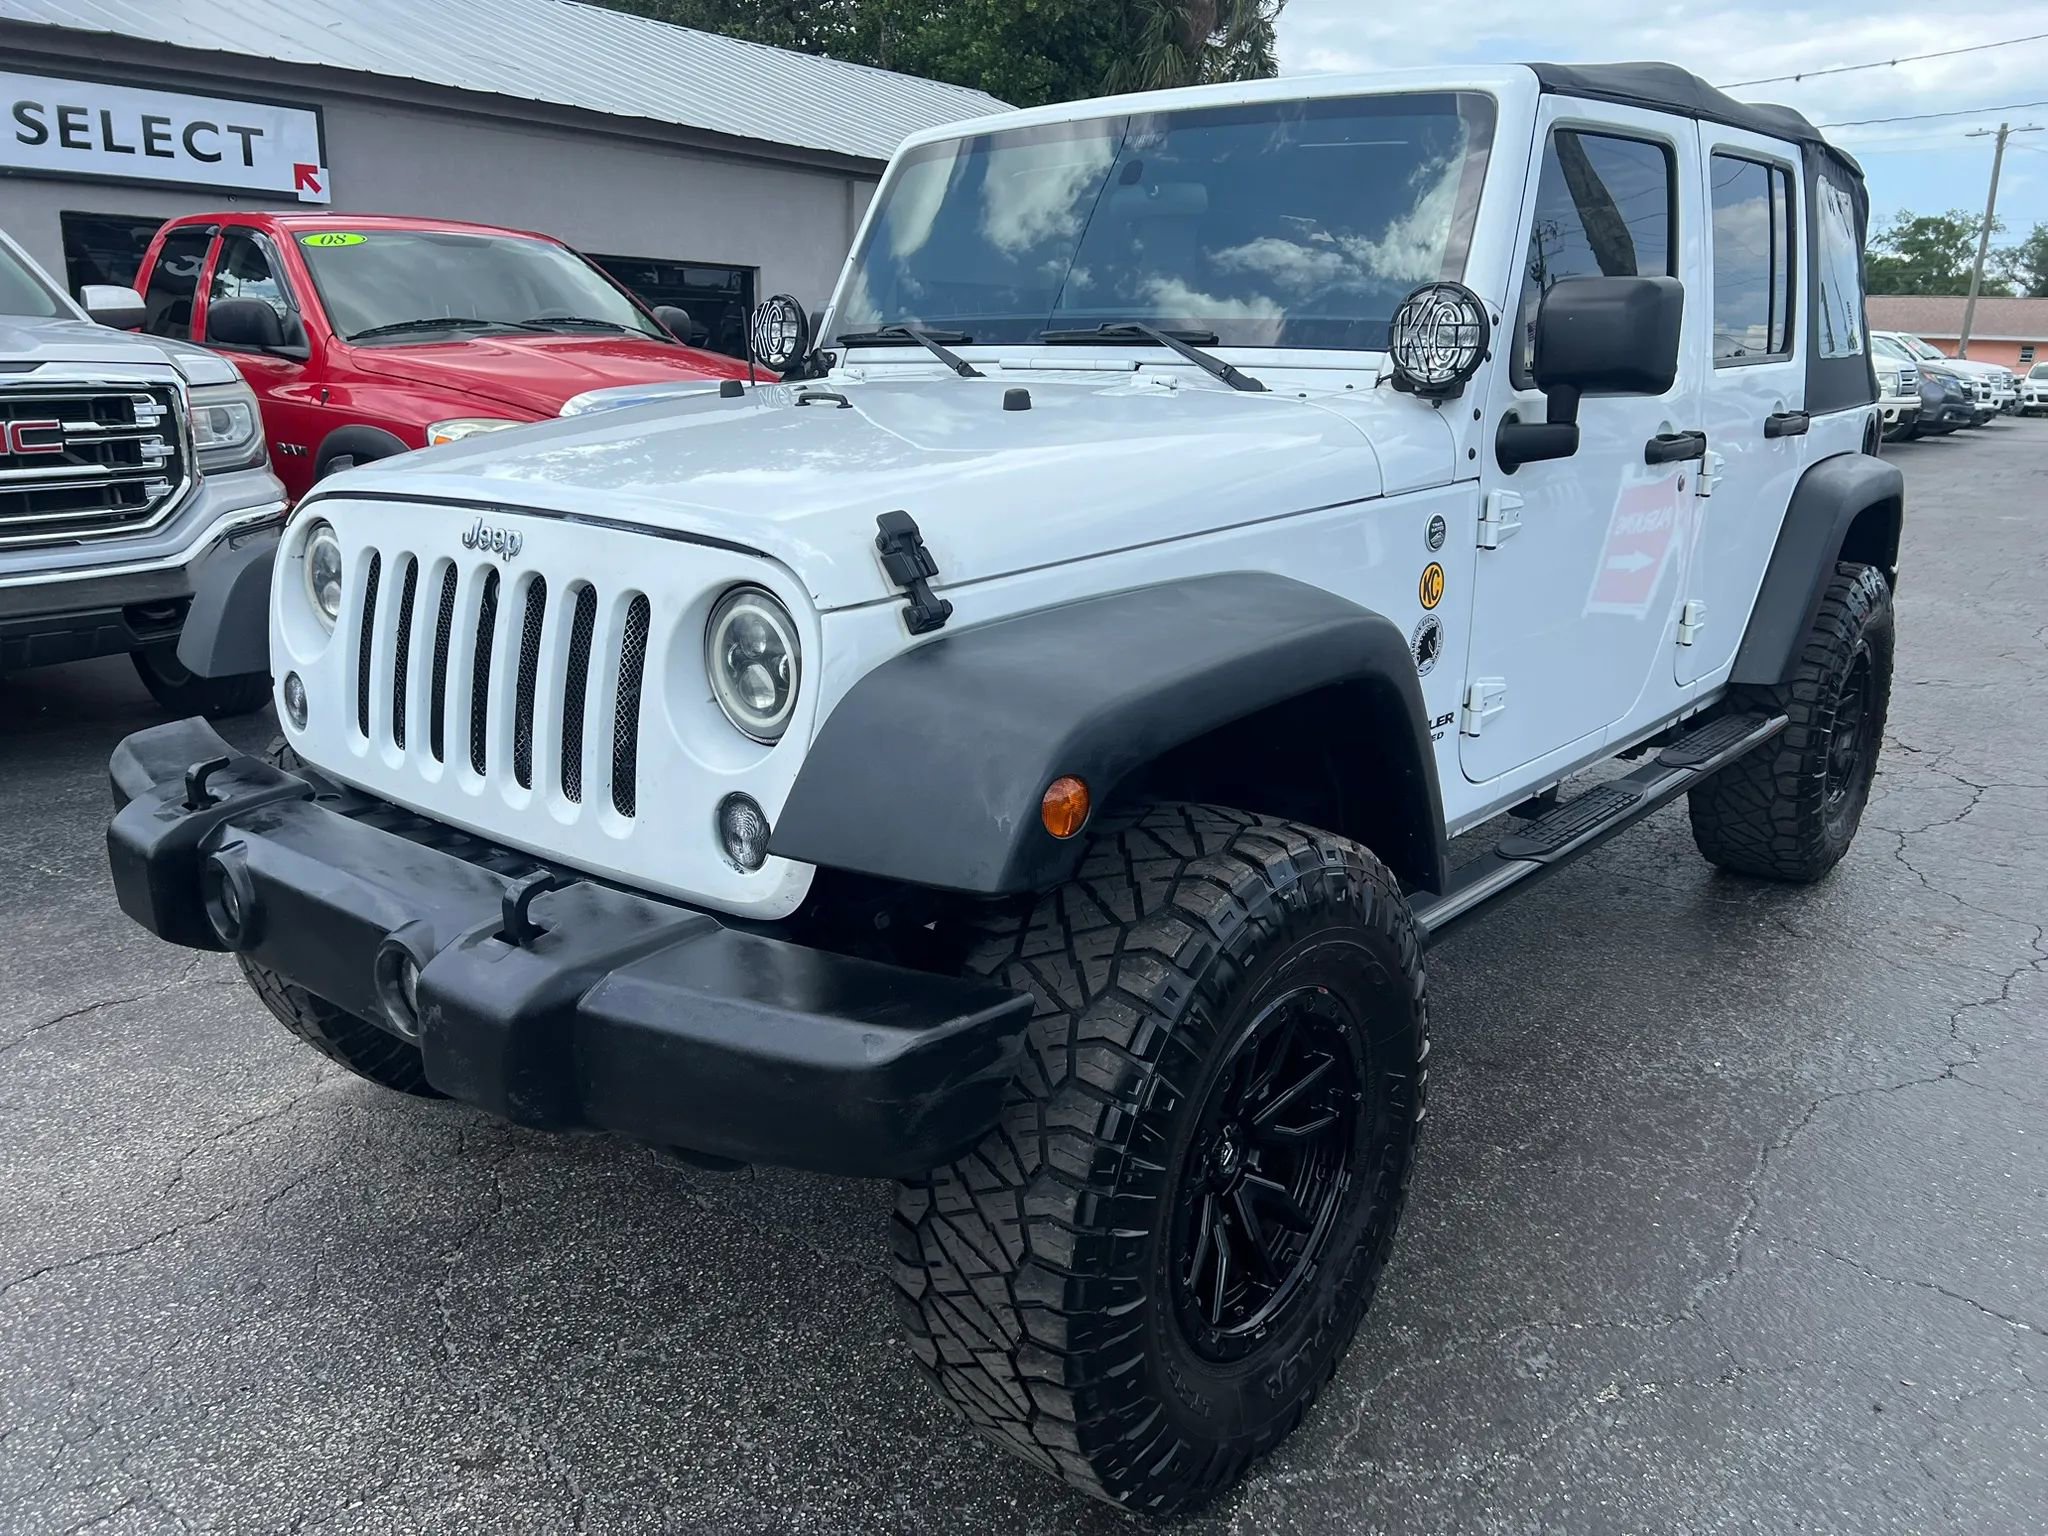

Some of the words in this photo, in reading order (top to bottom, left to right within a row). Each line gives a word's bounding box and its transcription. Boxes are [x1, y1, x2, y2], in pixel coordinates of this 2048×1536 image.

[12, 100, 264, 167] SELECT
[320, 234, 346, 245] 08
[751, 301, 783, 359] KC
[1398, 295, 1463, 376] KC
[462, 516, 523, 562] Jeep
[1423, 567, 1440, 605] KC
